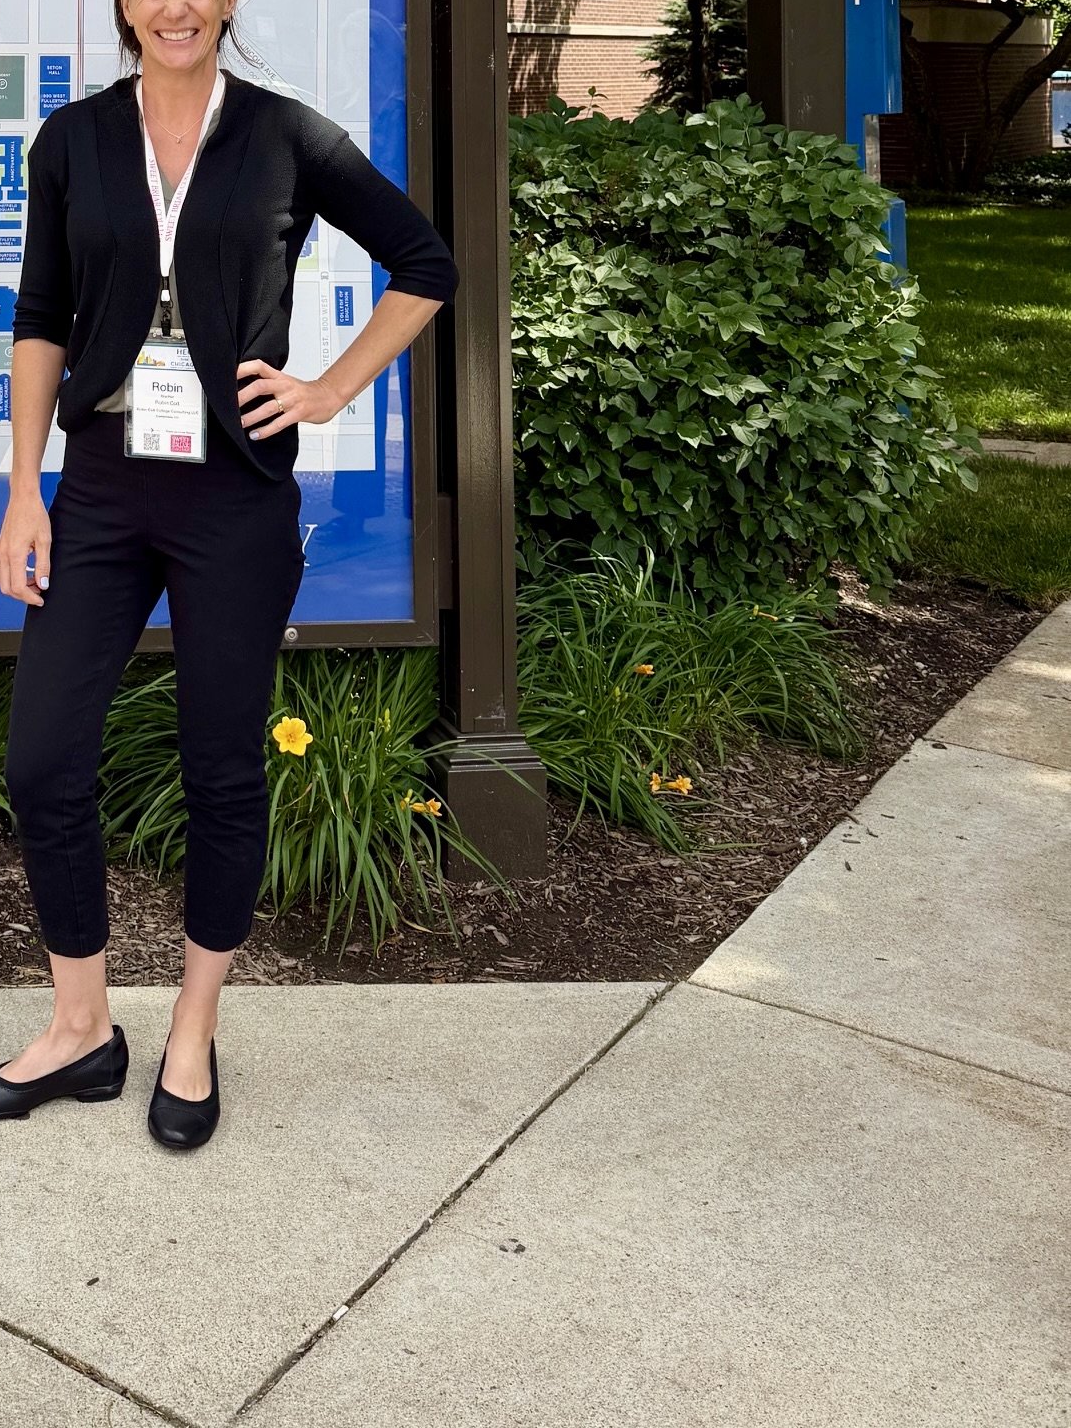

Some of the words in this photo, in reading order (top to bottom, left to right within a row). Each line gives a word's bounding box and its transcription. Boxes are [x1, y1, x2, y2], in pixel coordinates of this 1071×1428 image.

[241, 42, 266, 69] LINCOLN
[152, 382, 183, 393] Robin
[347, 405, 356, 414] N
